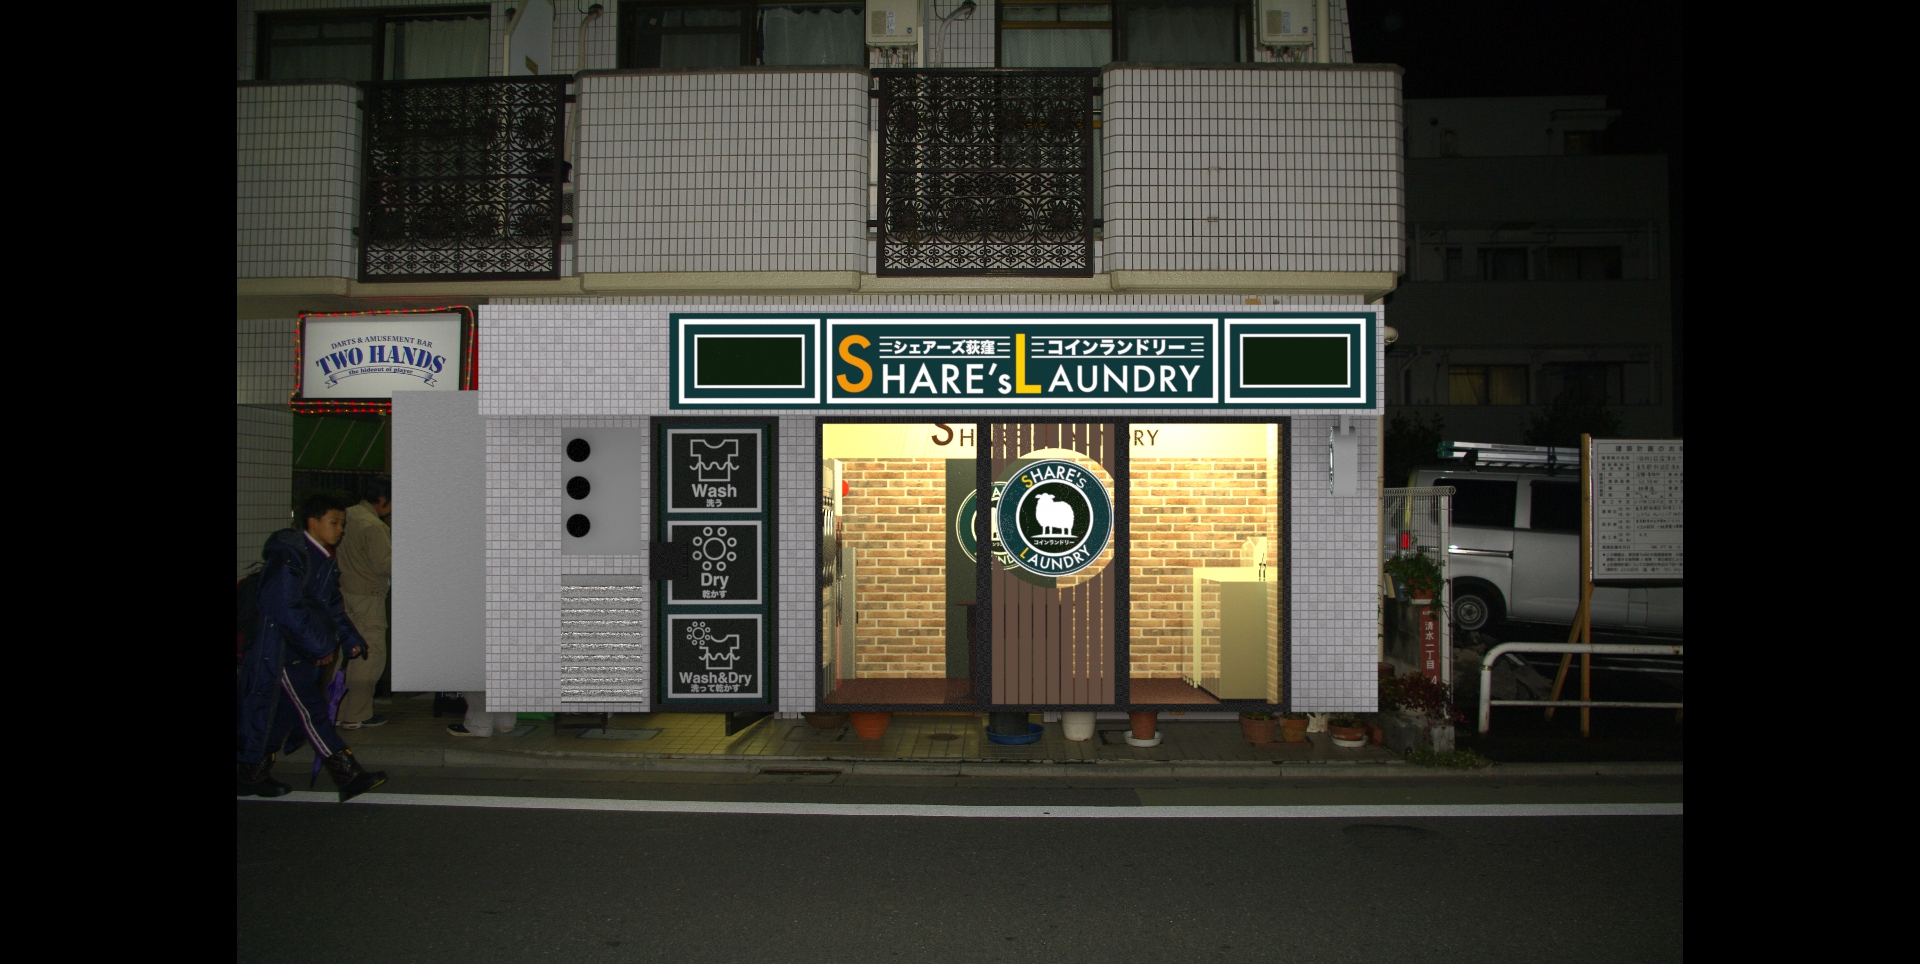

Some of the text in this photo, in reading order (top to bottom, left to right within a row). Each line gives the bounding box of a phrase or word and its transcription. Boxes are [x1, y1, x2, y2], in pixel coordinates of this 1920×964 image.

[331, 338, 356, 349] DARTS
[365, 335, 415, 343] AMUSEMENT
[417, 338, 433, 347] BAR
[893, 340, 996, 355] シェアーズ荻窪
[1047, 339, 1186, 355] コインランドリー
[315, 344, 447, 375] TWO HANDS
[1016, 333, 1201, 394] LAUNDRY
[393, 367, 414, 375] player
[692, 484, 737, 498] Wash
[706, 499, 723, 508] 洗う
[1019, 544, 1091, 570] LAUNDRY
[701, 573, 729, 589] Dry
[702, 590, 727, 599] 乾かす
[1424, 621, 1435, 669] 清水一丁目
[679, 672, 752, 686] Wash&Dry
[691, 684, 741, 693] 洗って乾かす
